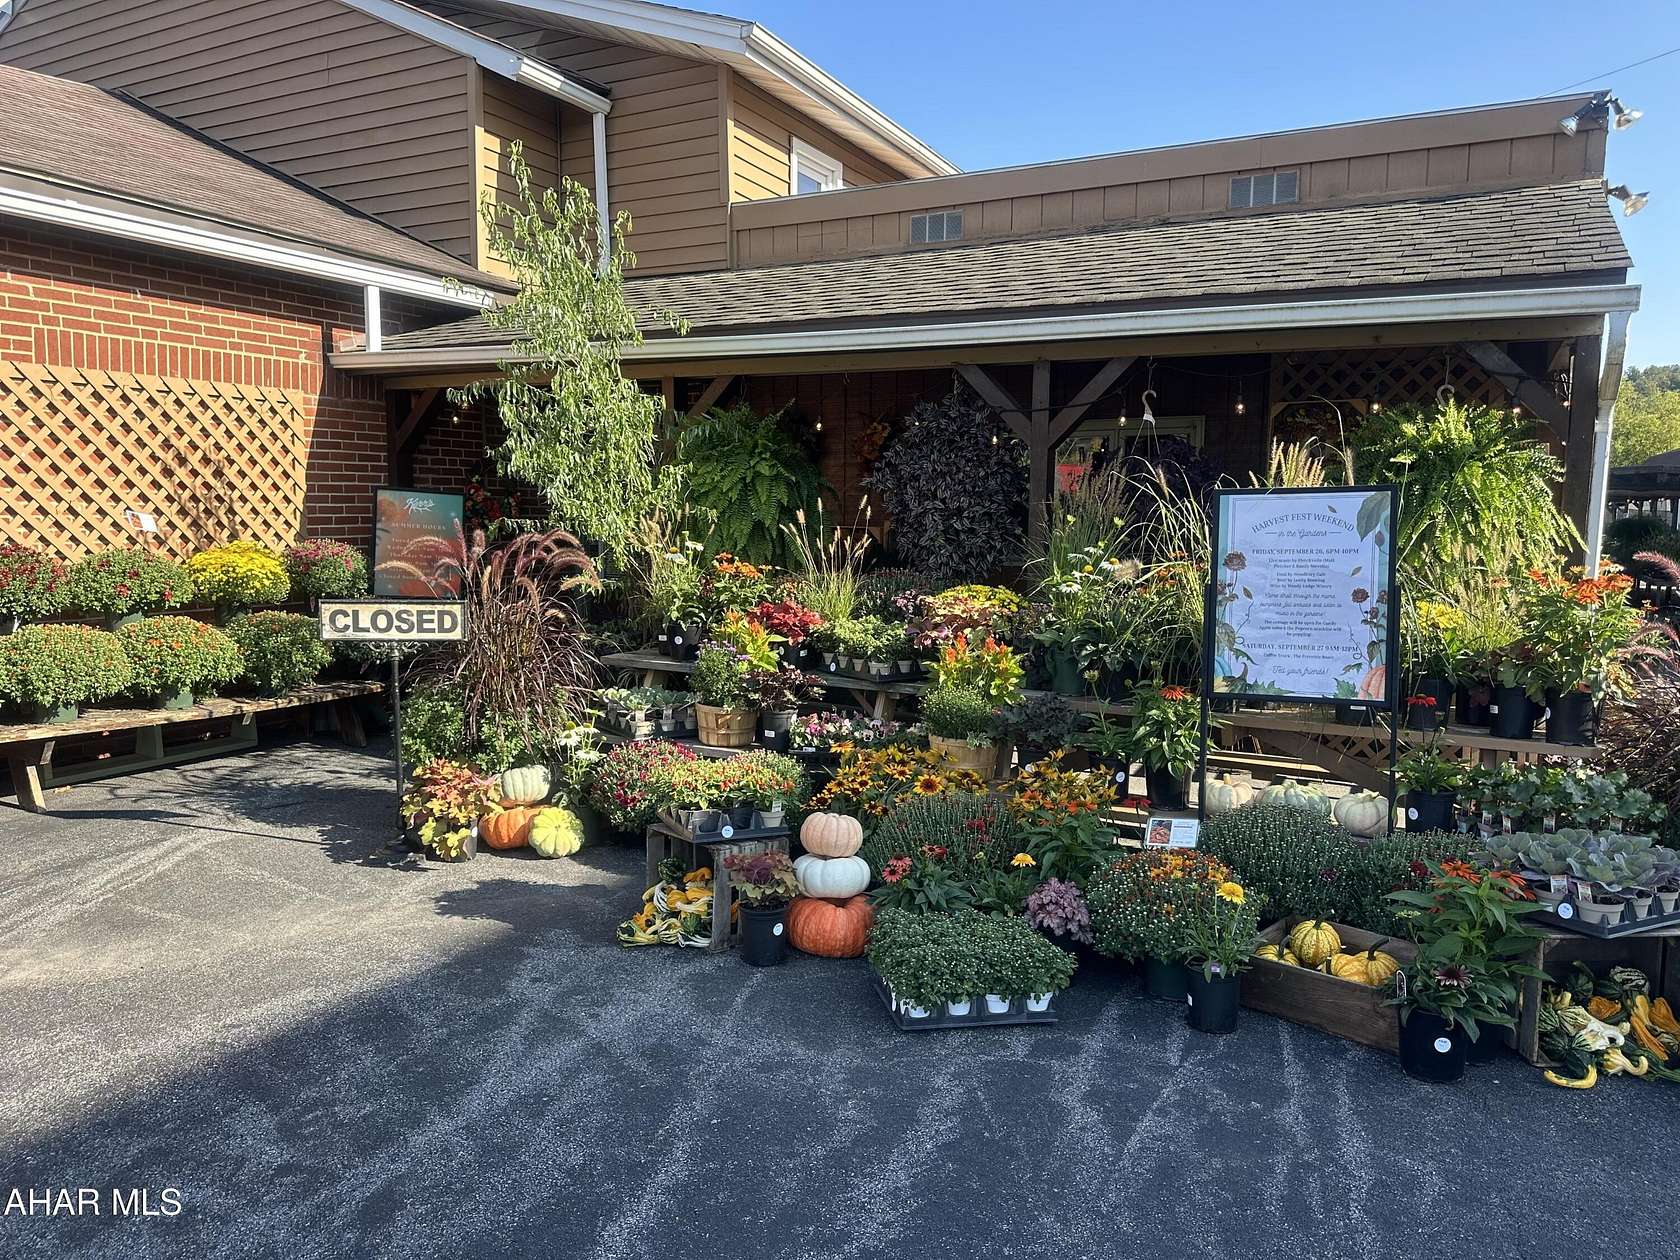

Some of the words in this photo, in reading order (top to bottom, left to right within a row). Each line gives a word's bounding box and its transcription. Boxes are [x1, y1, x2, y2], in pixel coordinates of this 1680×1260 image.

[1251, 514, 1289, 534] HARVEST
[1291, 512, 1312, 521] FEST
[1313, 513, 1355, 532] WEEKEND
[1286, 529, 1296, 537] the
[1298, 528, 1328, 539] Gardens
[328, 608, 459, 634] CLOSED
[1242, 643, 1277, 651] SATURDAY,
[1272, 665, 1285, 674] Tell
[1286, 667, 1302, 676] your
[1302, 665, 1329, 677] friends!
